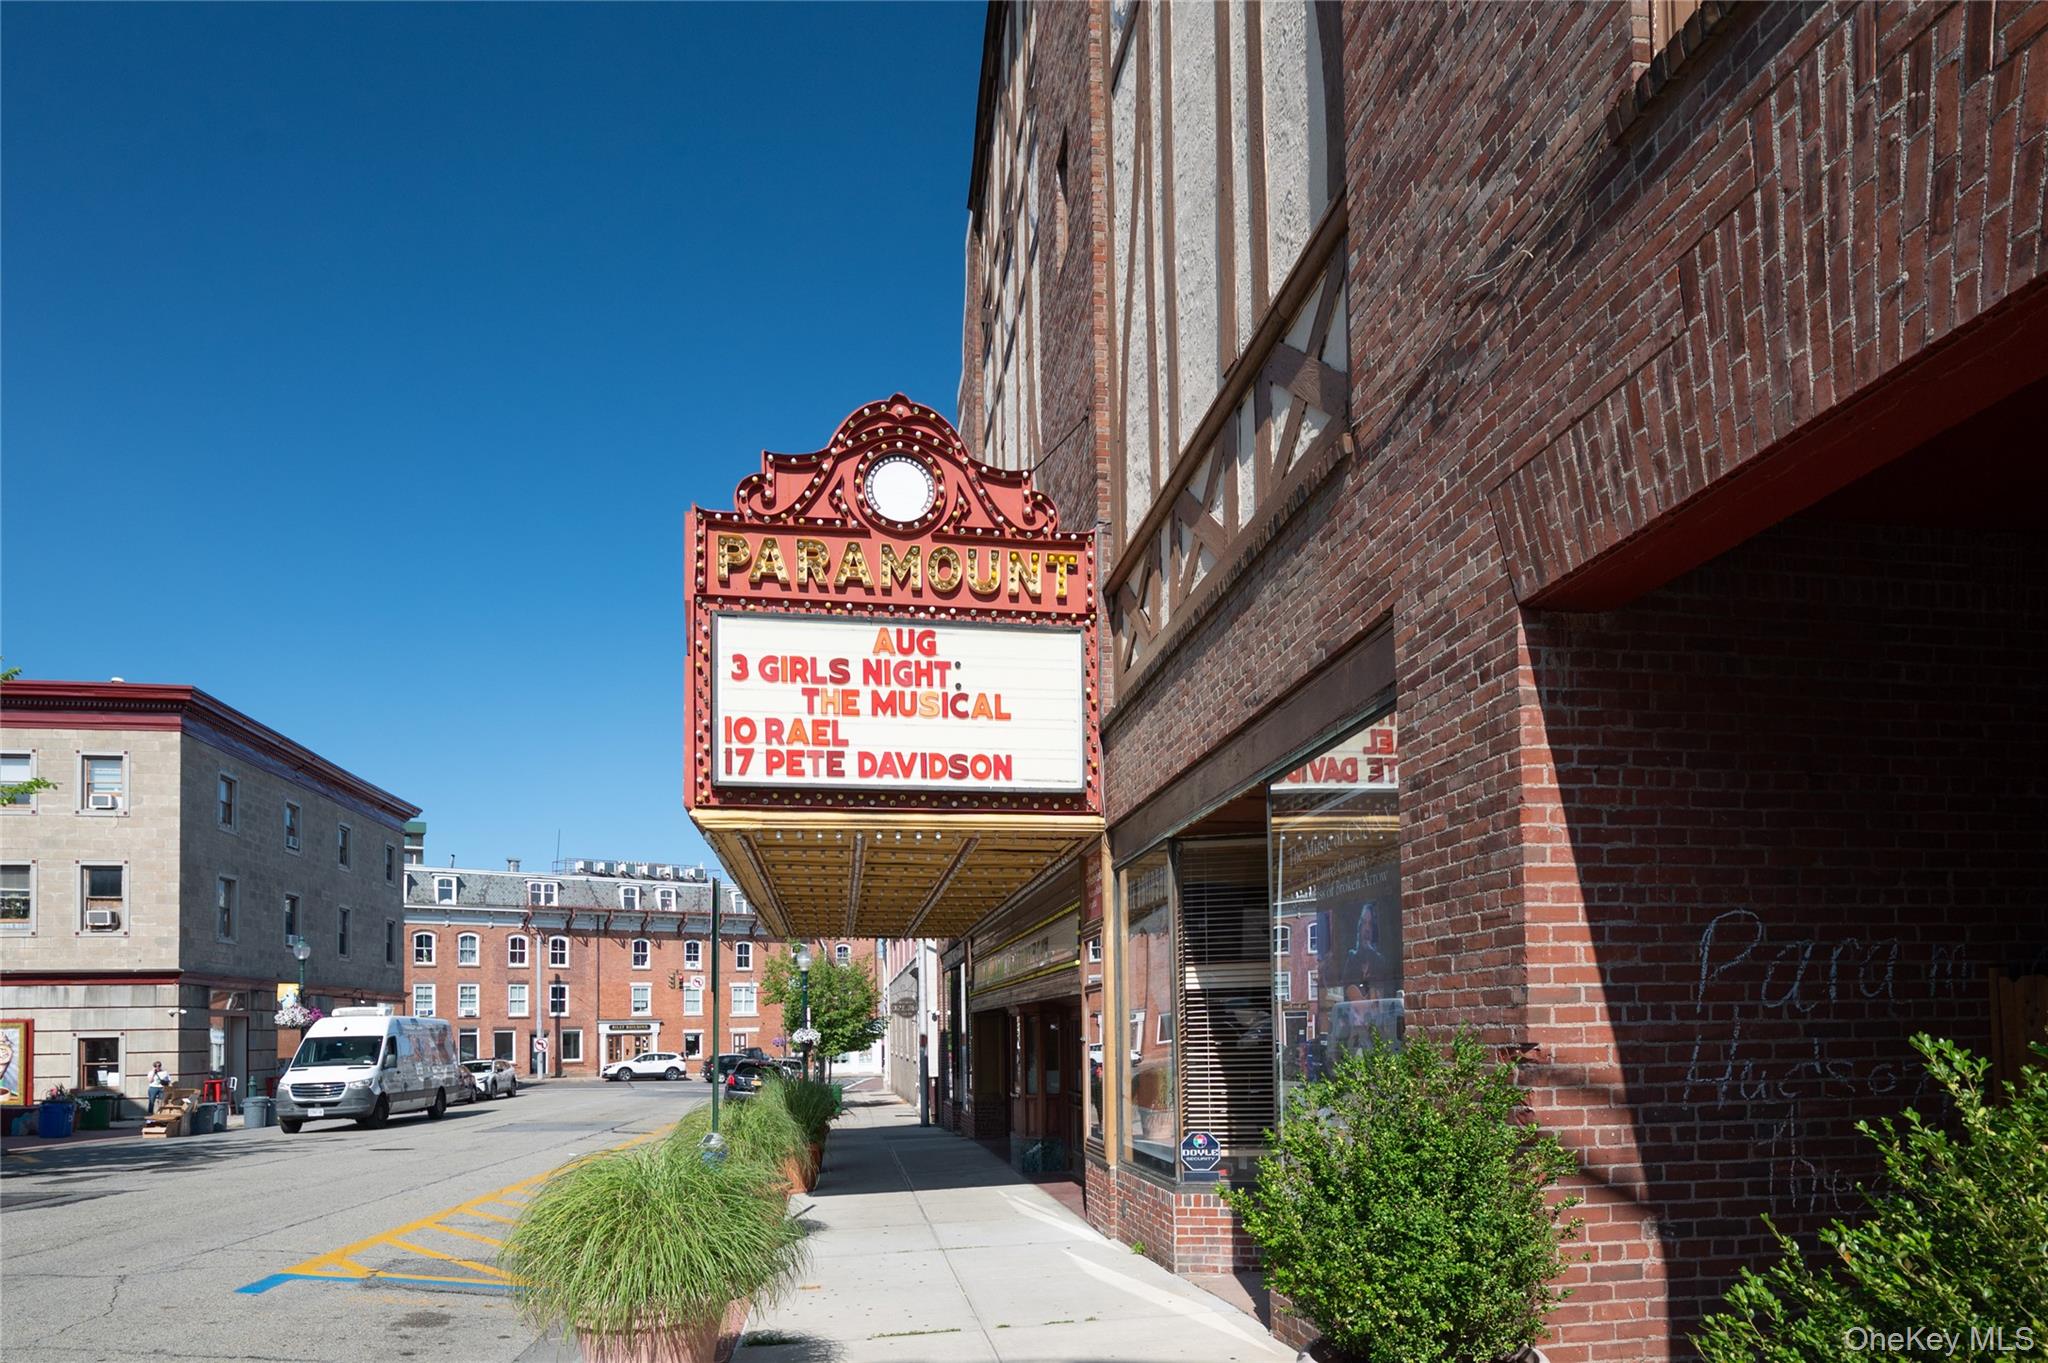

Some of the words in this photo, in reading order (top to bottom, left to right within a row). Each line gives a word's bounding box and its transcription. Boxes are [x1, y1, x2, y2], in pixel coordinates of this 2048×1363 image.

[716, 534, 1079, 599] PARAMOUNT
[872, 627, 938, 657] AUG
[731, 654, 750, 681] 3
[758, 655, 851, 684] GIRLS
[802, 688, 860, 718] THE
[871, 690, 1012, 720] MUSICAL
[765, 717, 849, 747] RAEL
[724, 747, 756, 775] 17
[765, 749, 845, 778] PETE
[858, 751, 1012, 781] DAVIDSON
[1182, 1149, 1219, 1157] DOYLE
